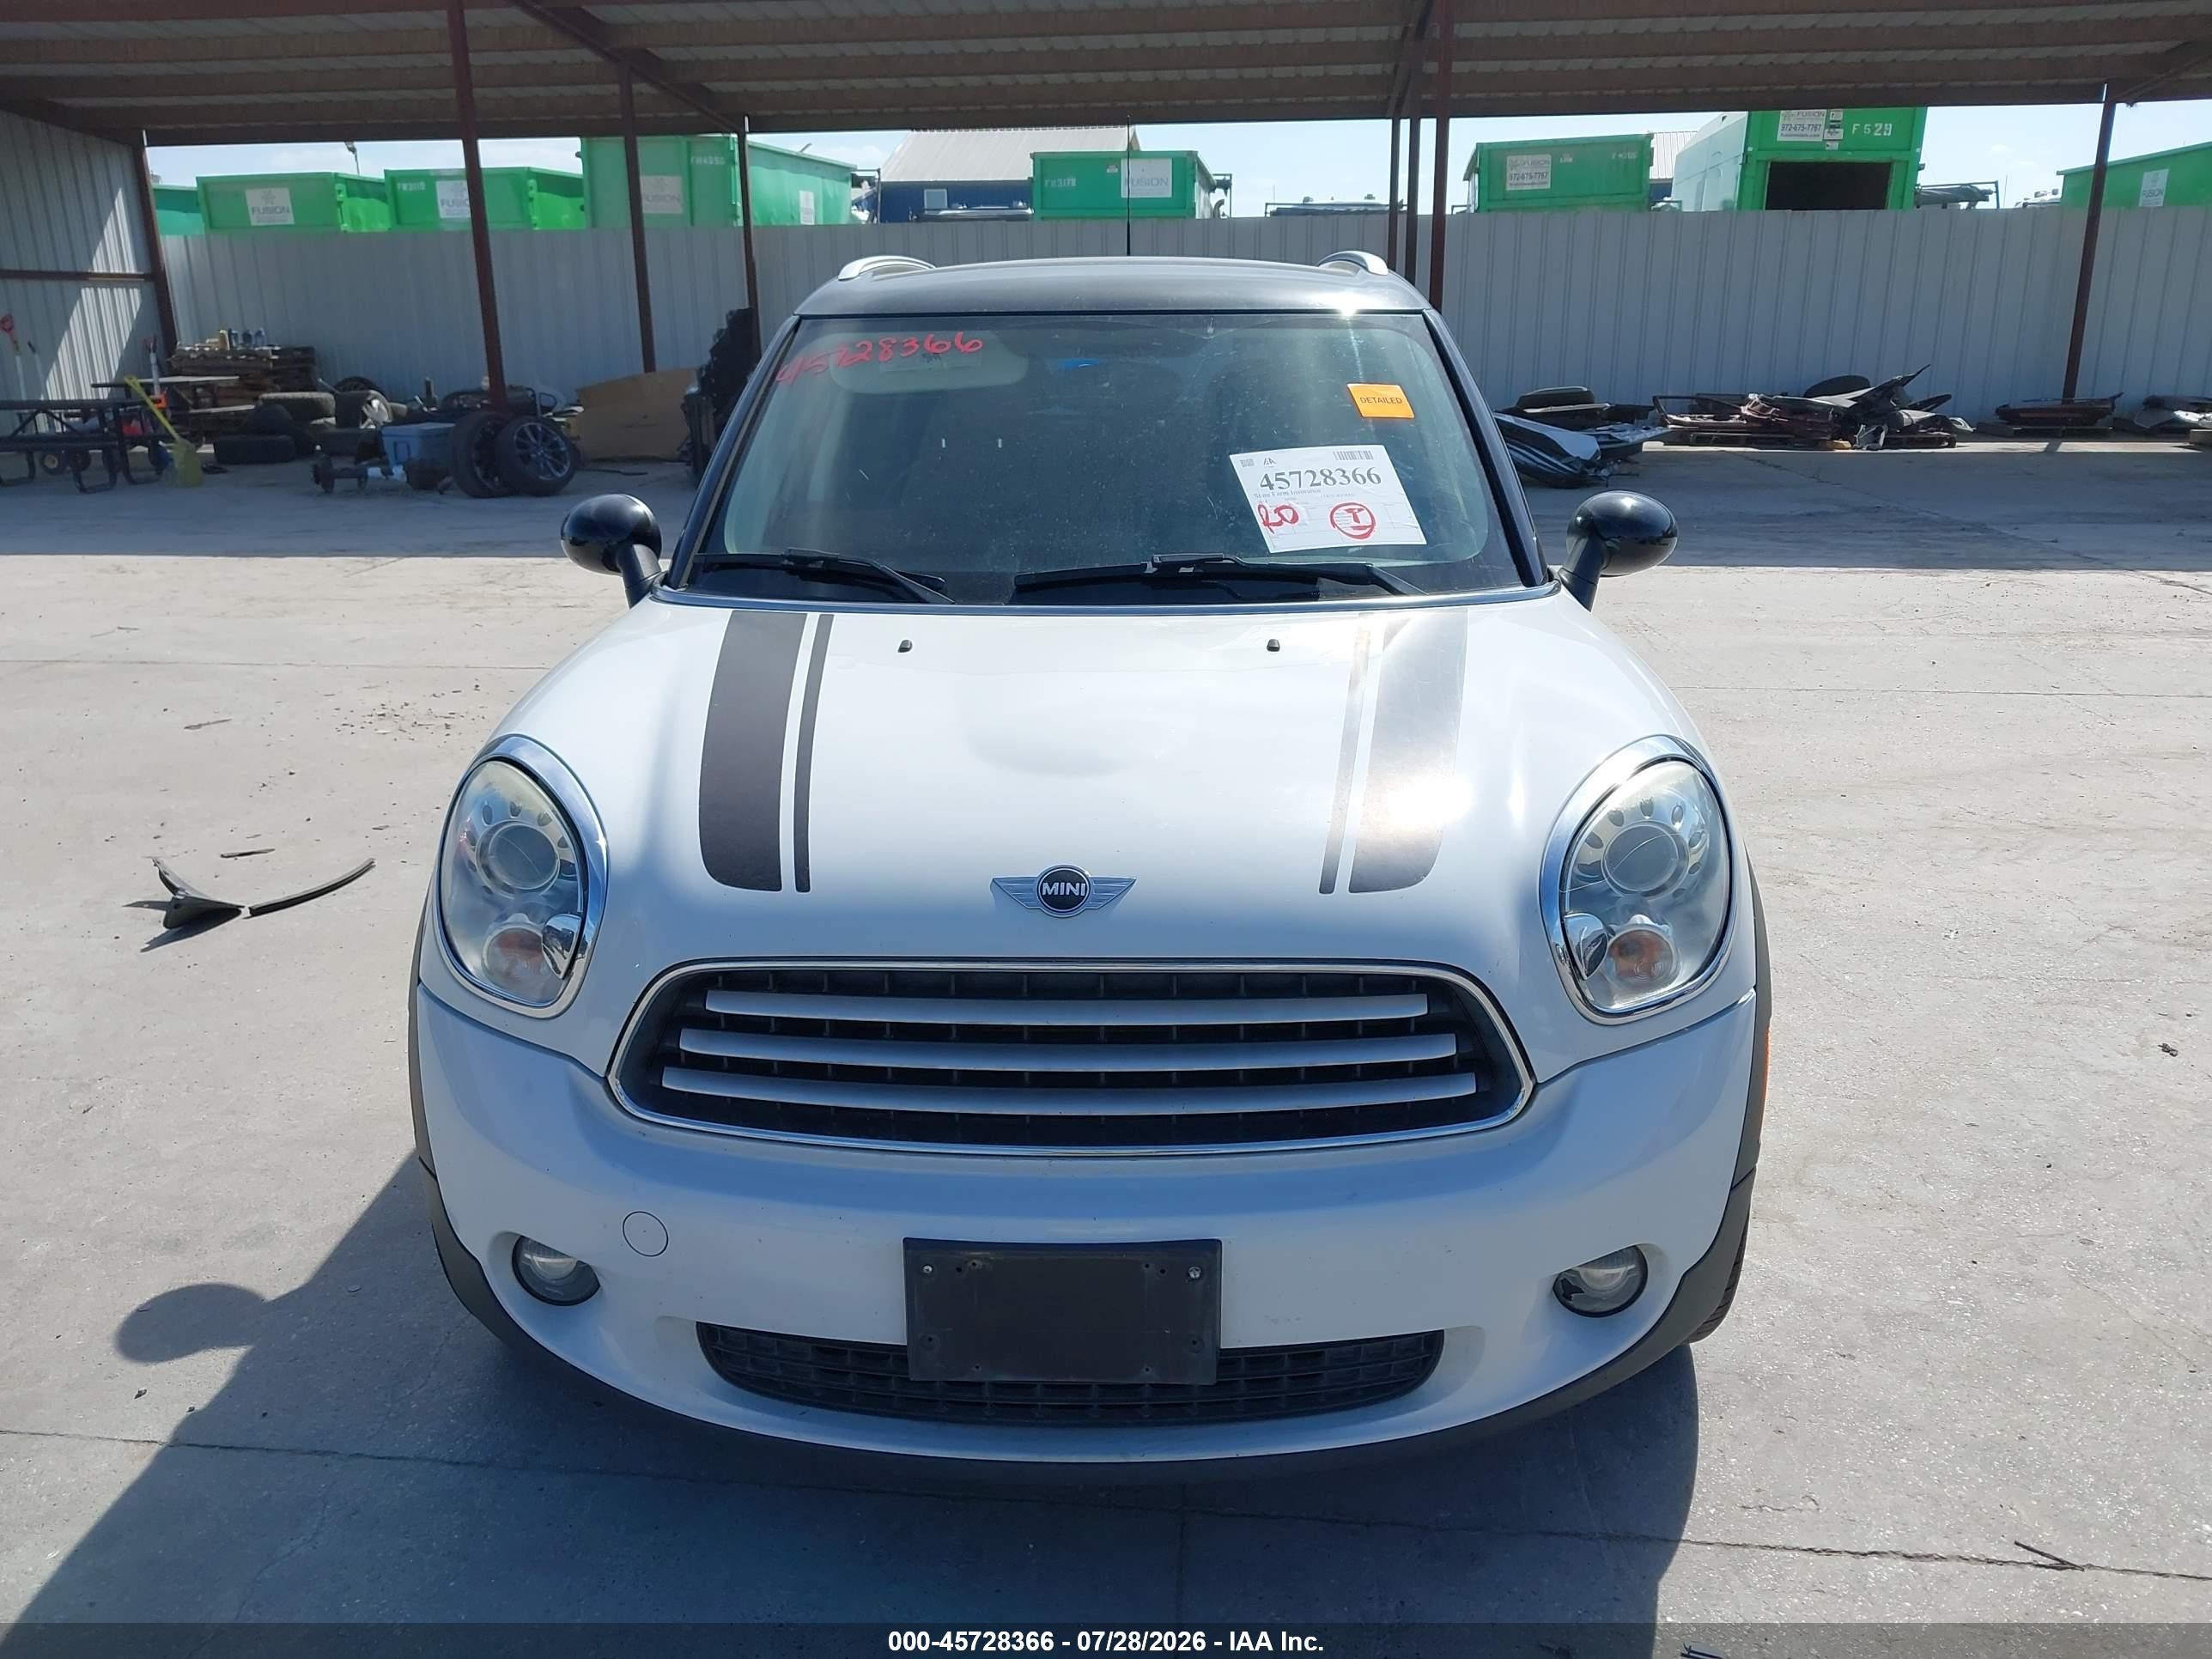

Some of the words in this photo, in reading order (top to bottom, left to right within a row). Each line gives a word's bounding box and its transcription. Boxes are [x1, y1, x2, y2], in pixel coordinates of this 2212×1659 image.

[775, 331, 984, 385] 45728366
[1260, 466, 1382, 490] 45728366
[1042, 882, 1086, 896] MINI
